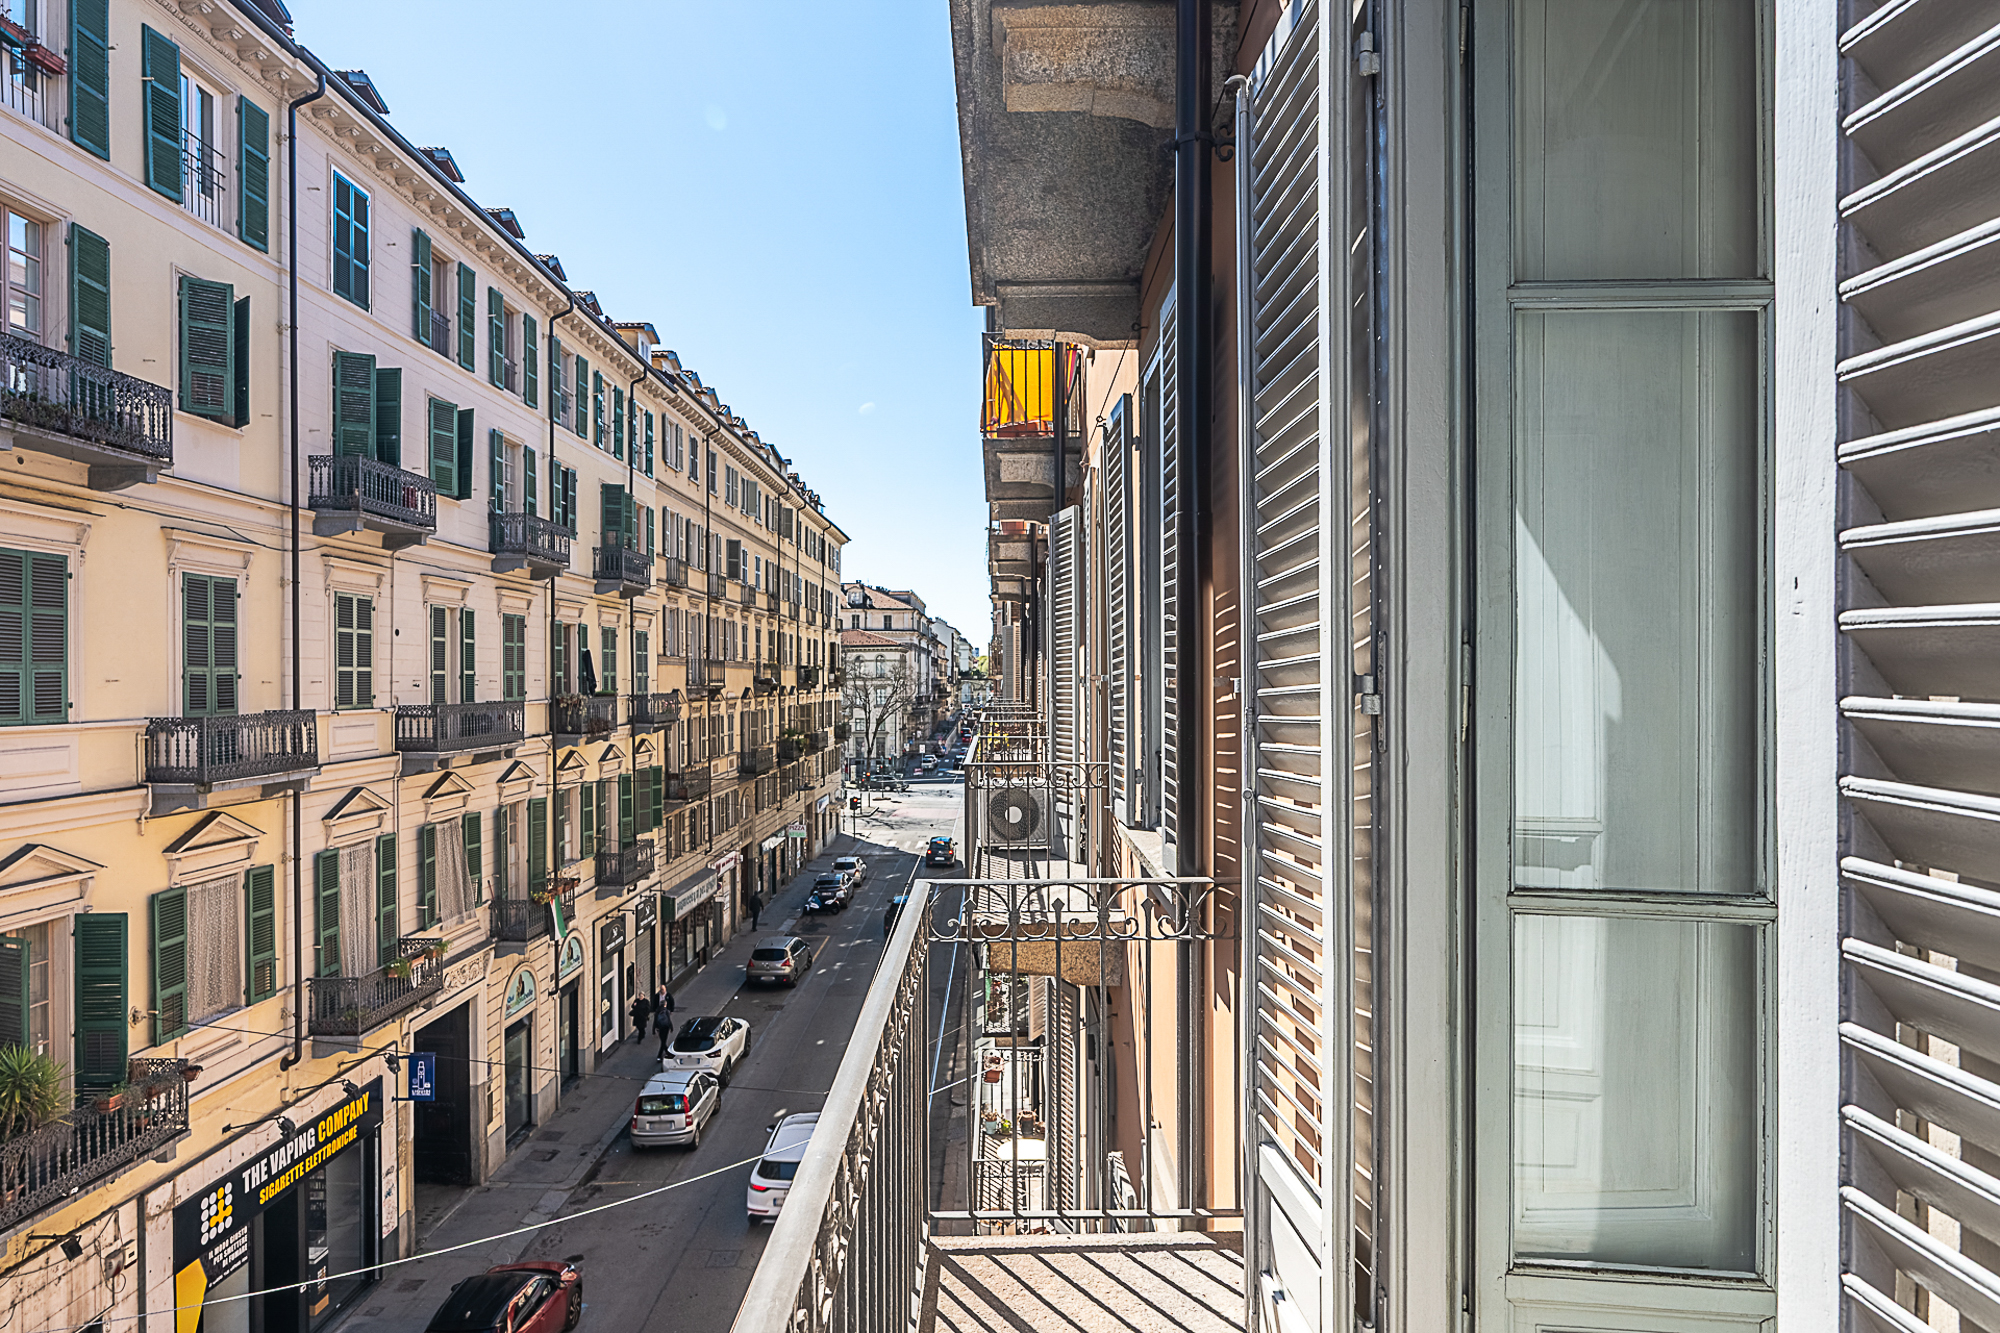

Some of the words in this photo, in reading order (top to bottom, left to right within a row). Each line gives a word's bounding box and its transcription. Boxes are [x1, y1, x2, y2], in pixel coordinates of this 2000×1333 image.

[242, 1157, 268, 1194] THE
[269, 1127, 316, 1176] VAPING
[317, 1091, 370, 1142] COMPANY
[259, 1162, 304, 1205] SIGARETTE
[305, 1124, 358, 1172] ELETTRONICHE
[208, 1250, 214, 1260] IL
[230, 1225, 248, 1244] GIUSTO
[213, 1253, 223, 1265] PER
[224, 1234, 248, 1258] SMETTERE
[229, 1243, 248, 1263] FUMARE
